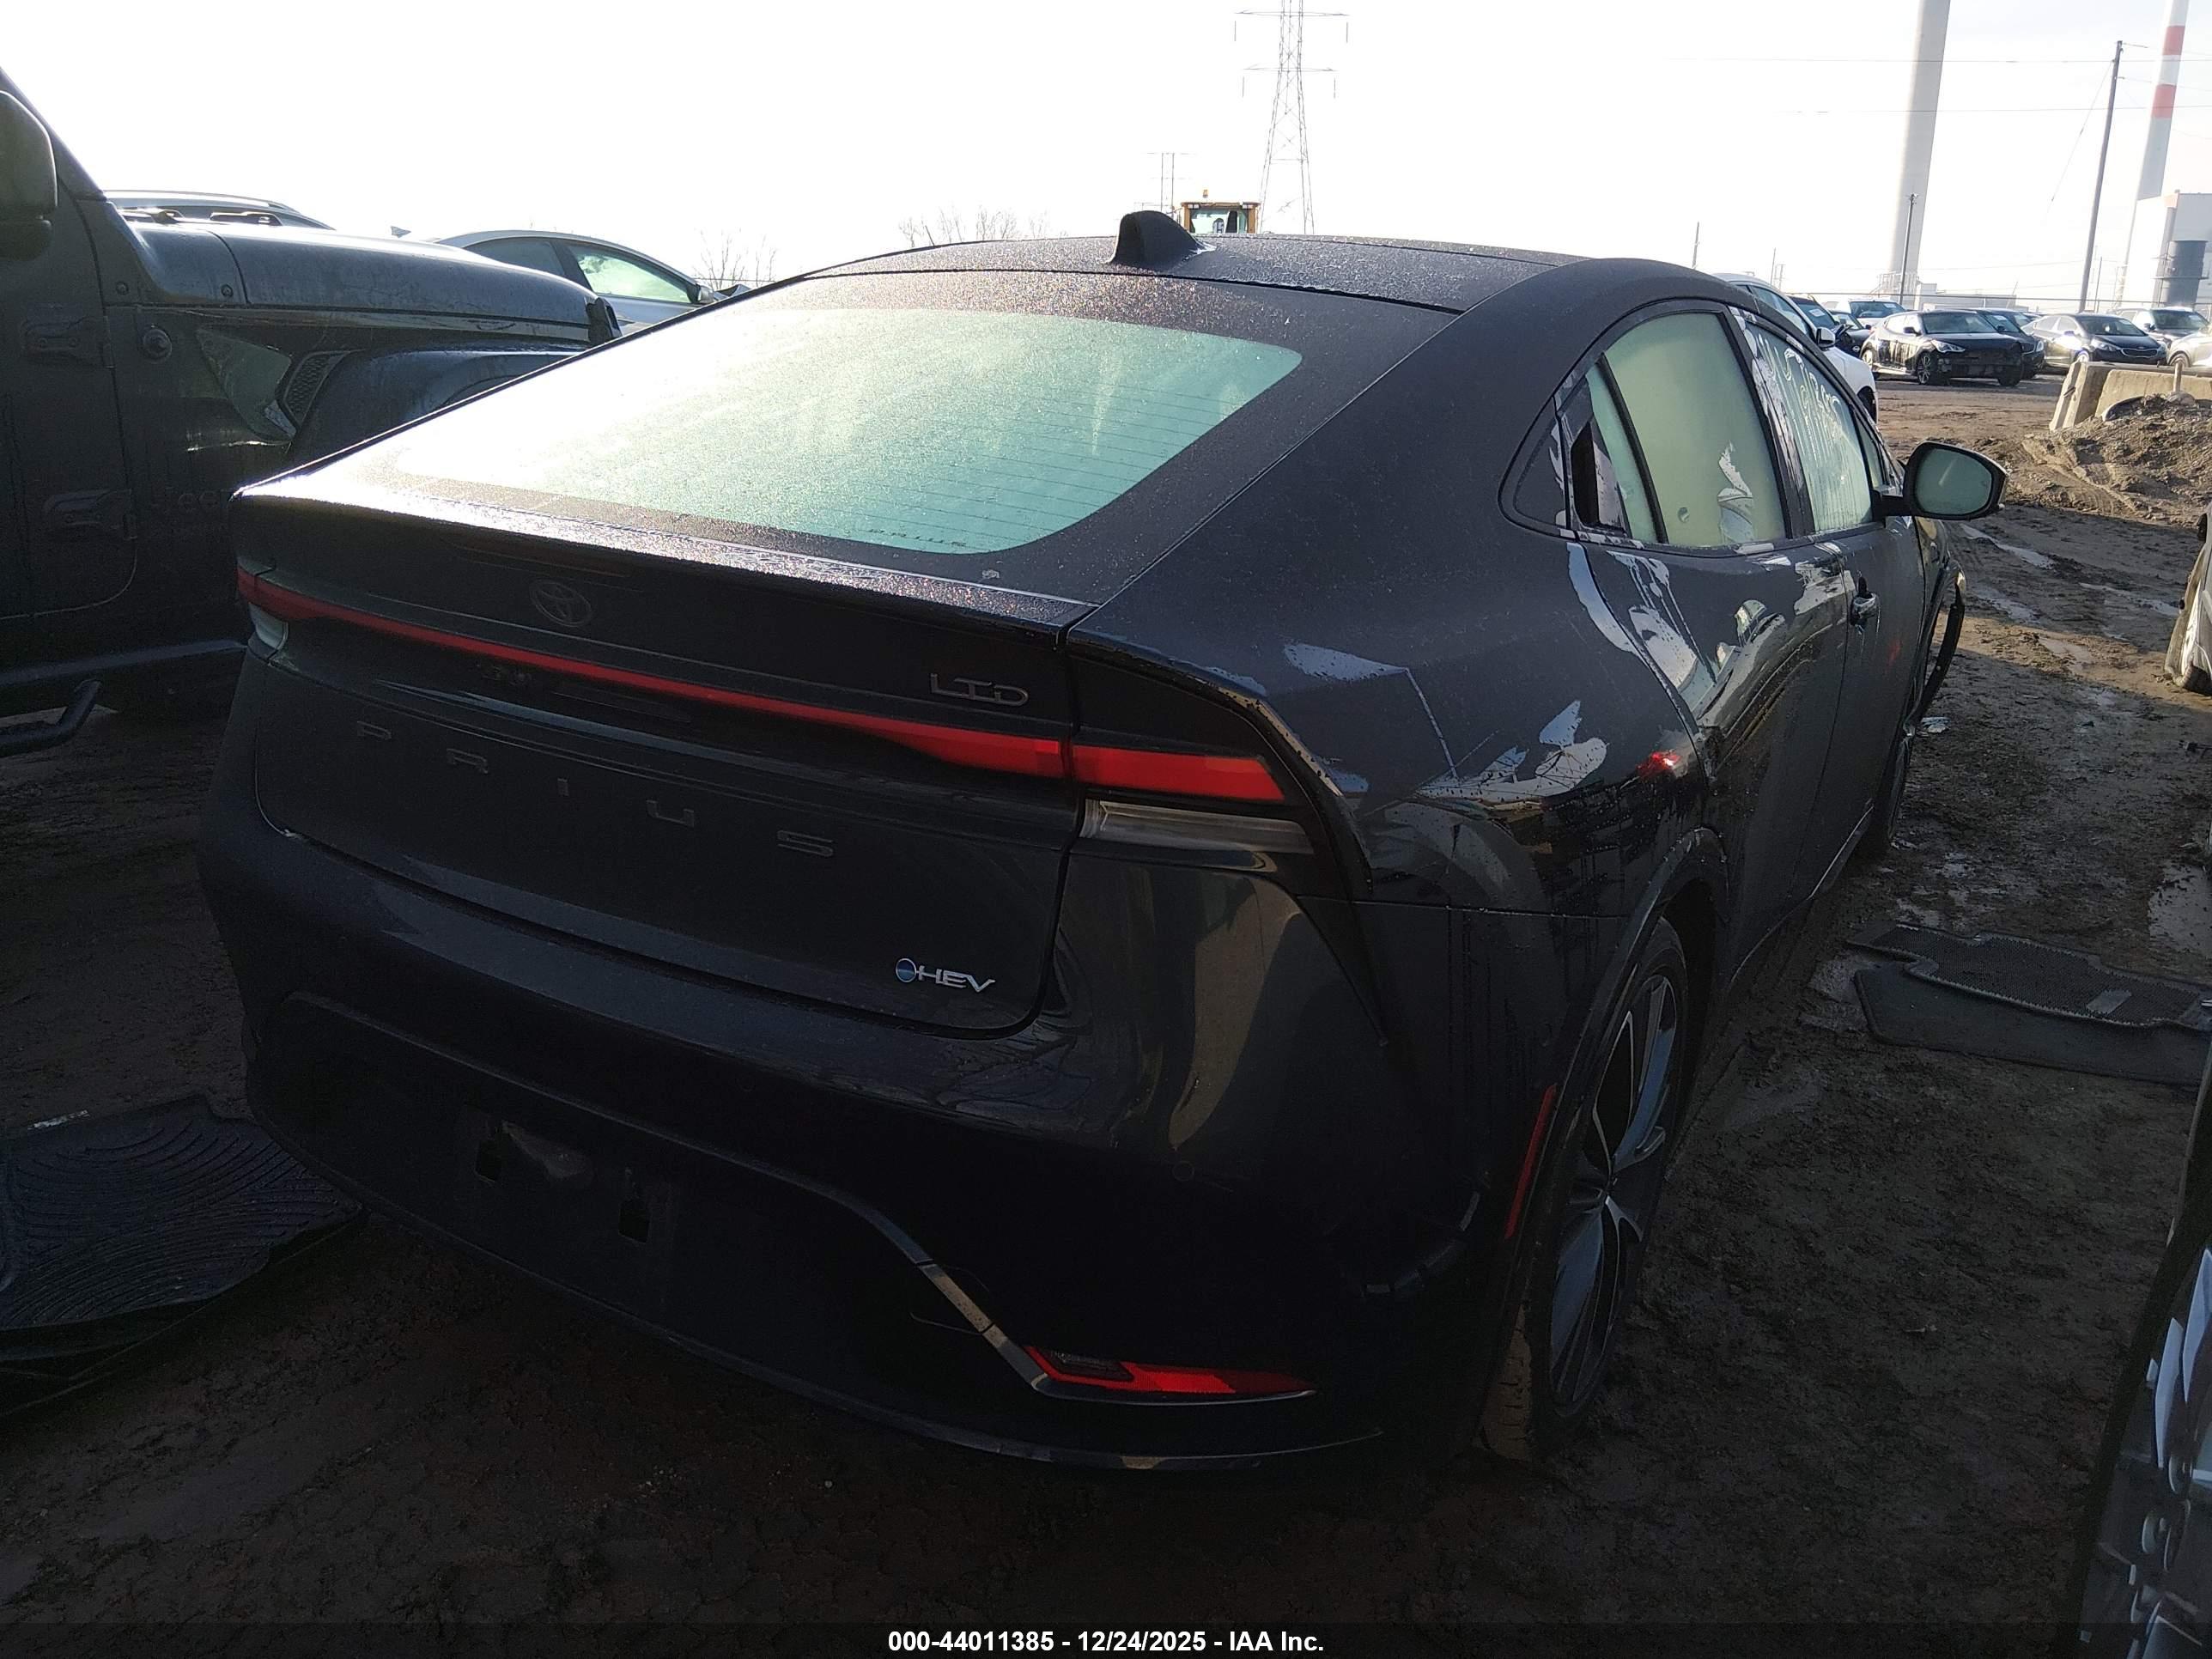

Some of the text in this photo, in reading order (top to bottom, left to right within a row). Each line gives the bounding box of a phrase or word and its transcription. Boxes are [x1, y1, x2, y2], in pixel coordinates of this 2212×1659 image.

[930, 672, 1030, 708] LTD
[356, 720, 836, 859] PRIUS
[912, 961, 997, 993] HEV
